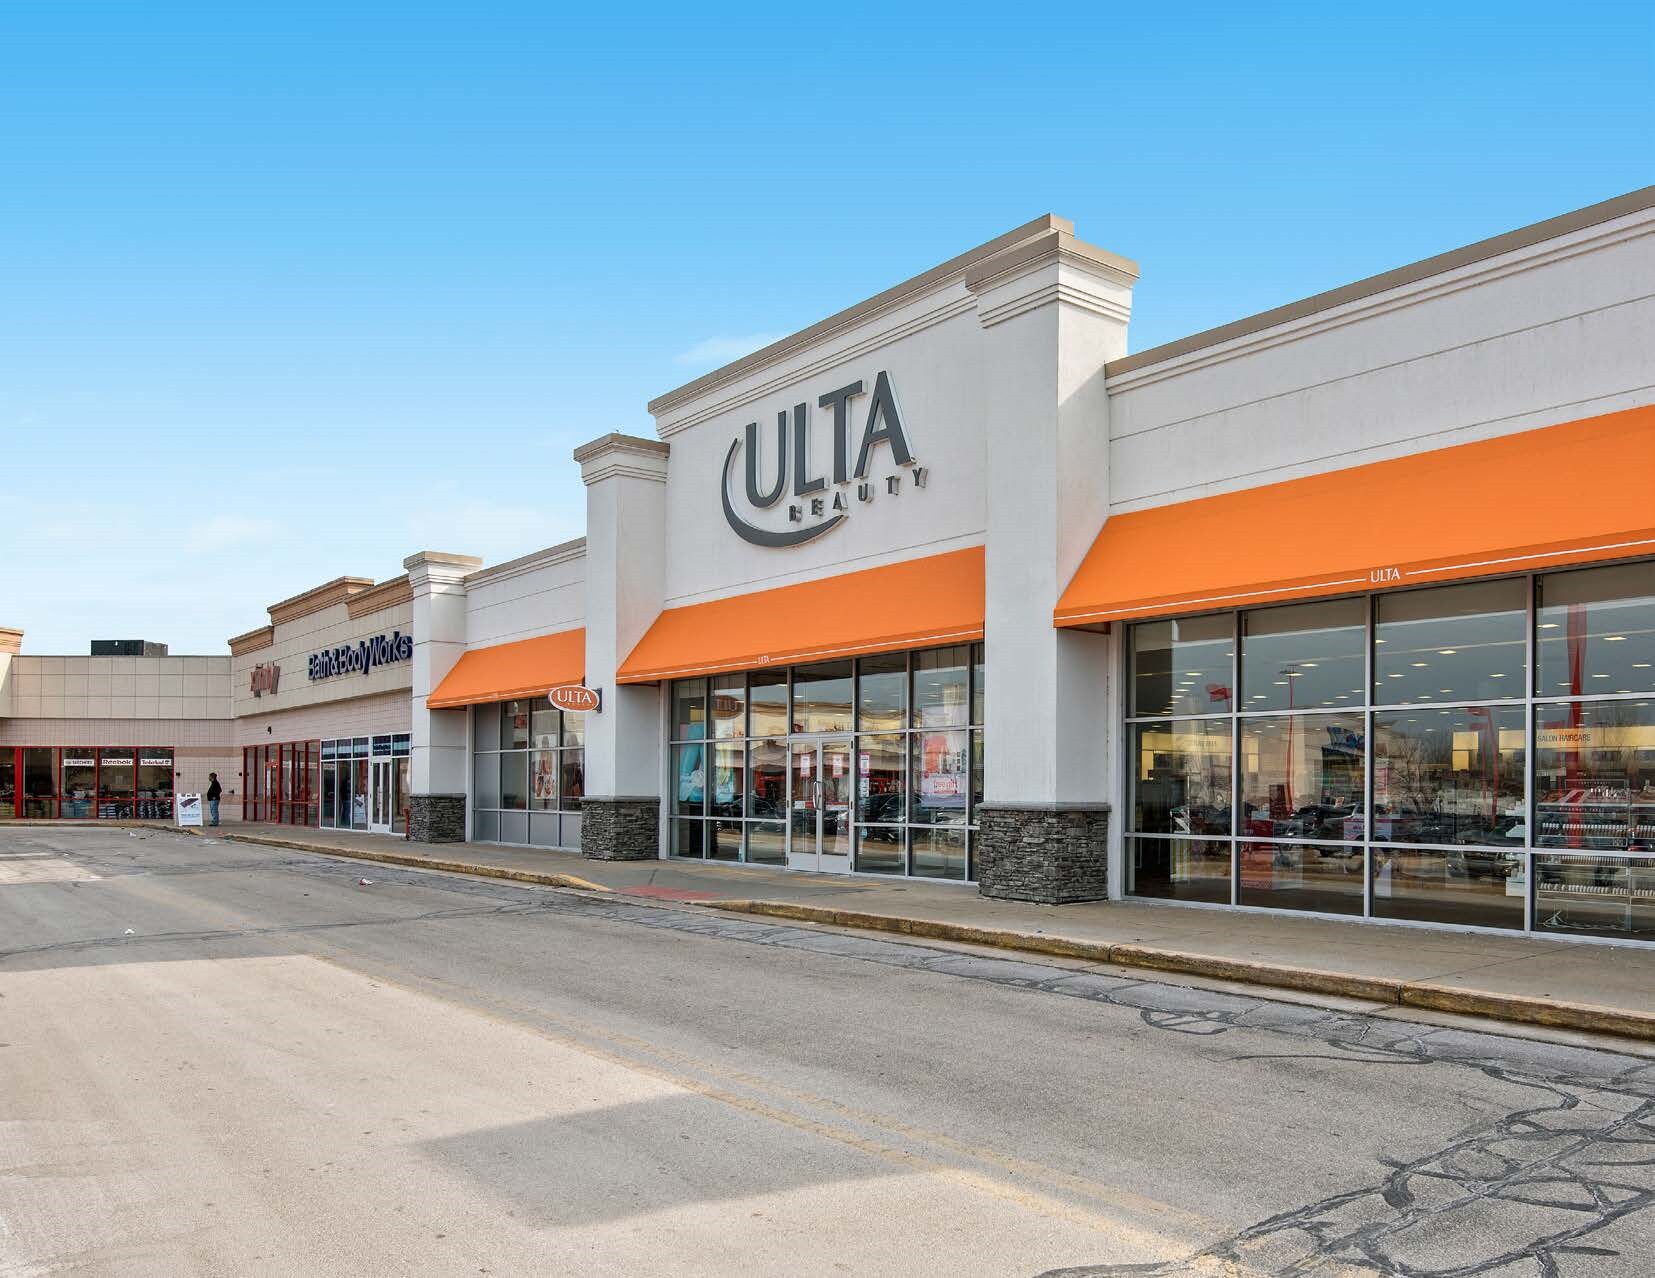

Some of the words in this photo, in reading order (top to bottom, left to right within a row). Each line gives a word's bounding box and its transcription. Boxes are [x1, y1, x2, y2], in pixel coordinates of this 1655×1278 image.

[745, 370, 914, 508] ULTA
[788, 467, 928, 522] BEAUTY
[1370, 567, 1401, 583] ULTA
[308, 649, 330, 680] Bath
[339, 641, 370, 675] Body
[369, 631, 413, 667] Works
[557, 690, 592, 704] ULTA
